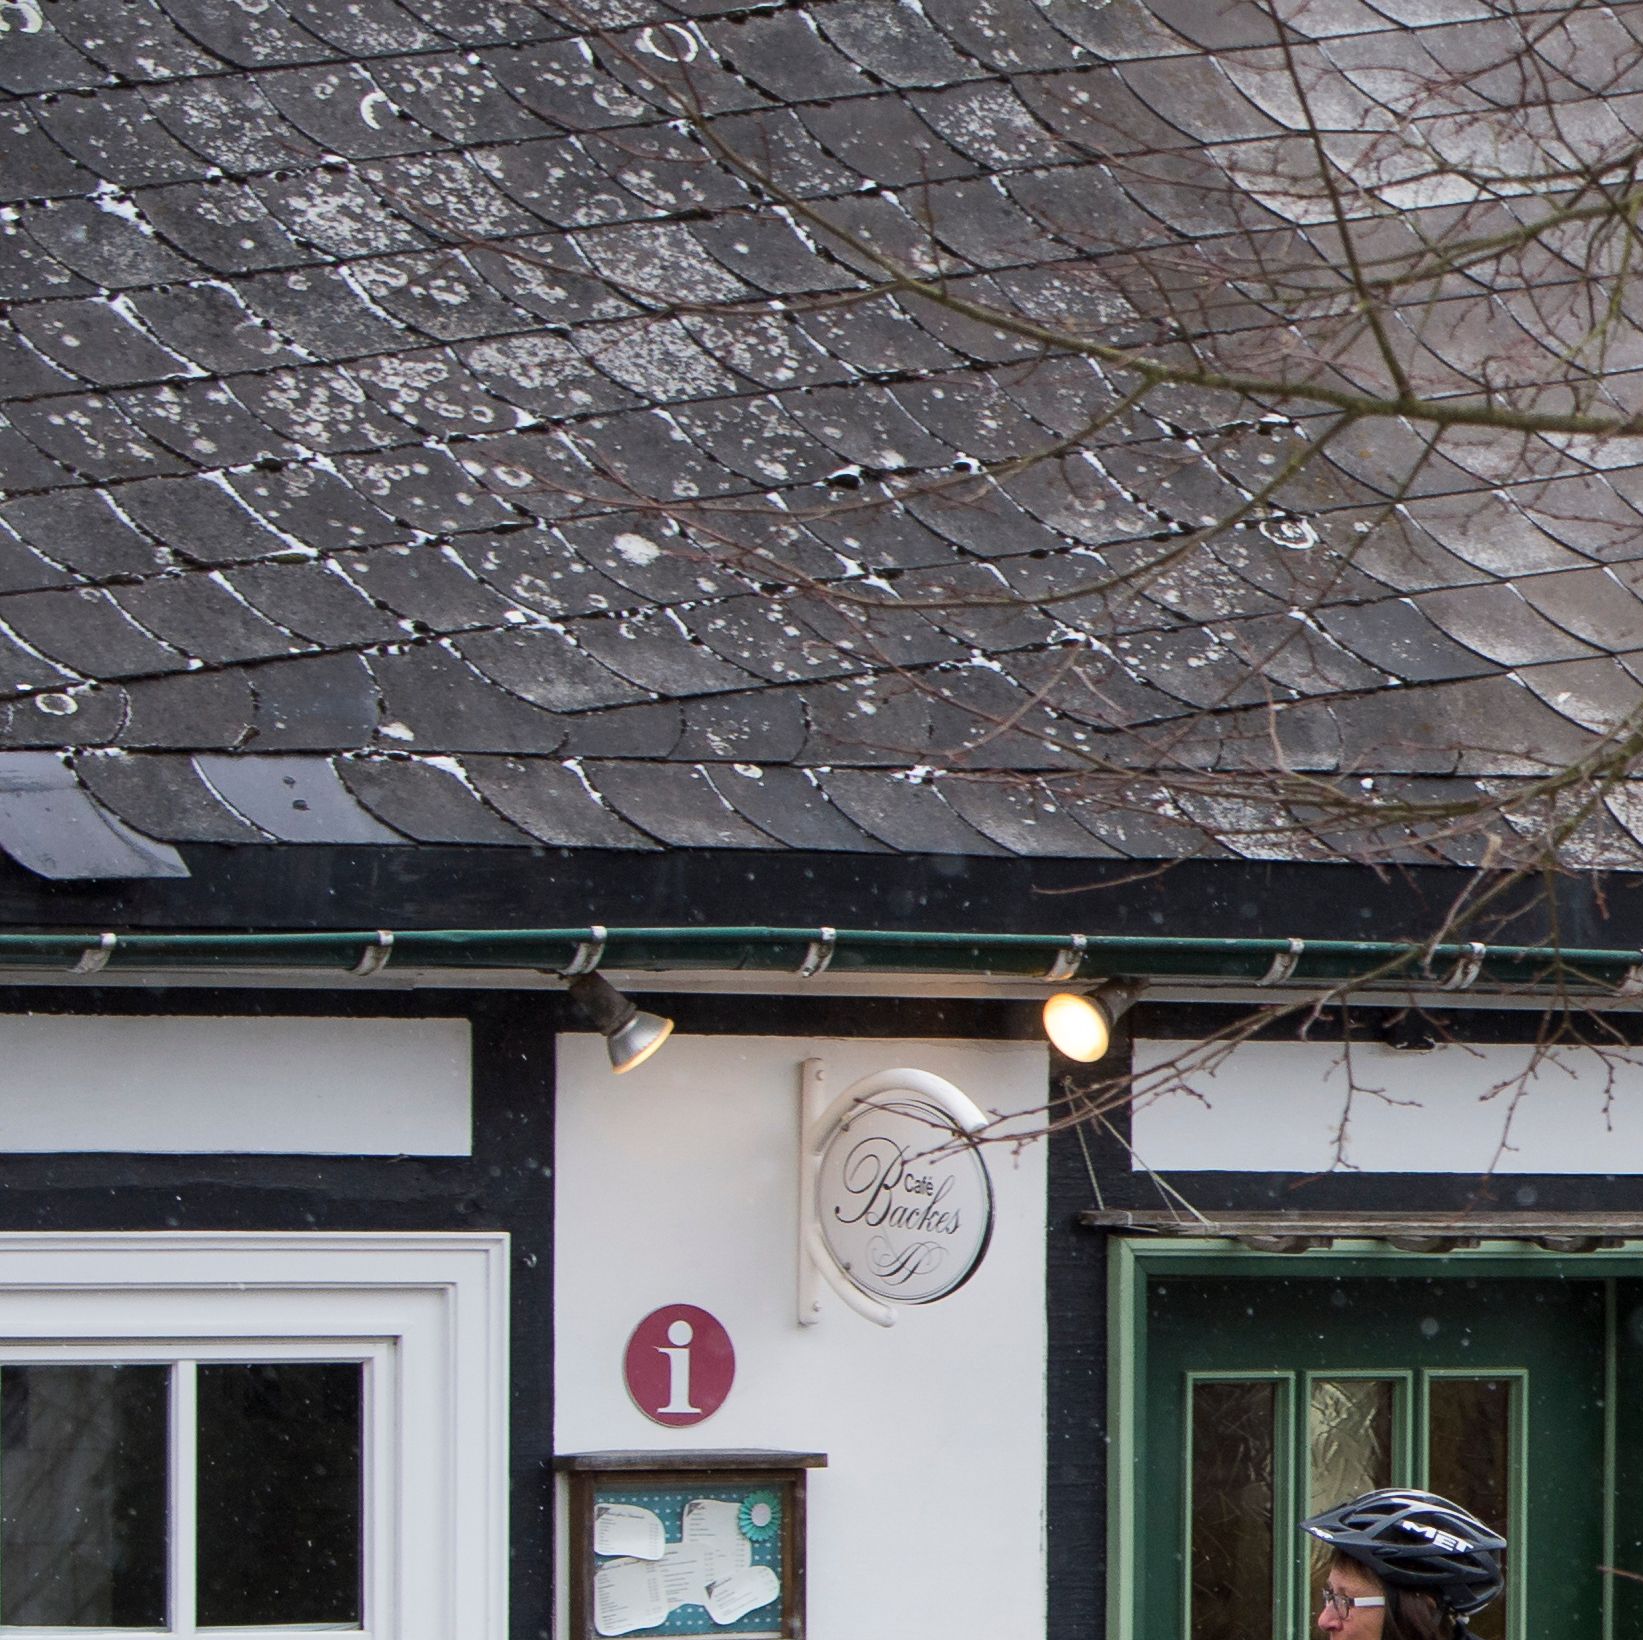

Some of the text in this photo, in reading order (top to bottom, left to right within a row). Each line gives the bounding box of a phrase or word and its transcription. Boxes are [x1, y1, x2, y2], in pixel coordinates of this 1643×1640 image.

[835, 1137, 960, 1234] Backes
[904, 1173, 934, 1196] Café
[1402, 1519, 1474, 1553] MET
